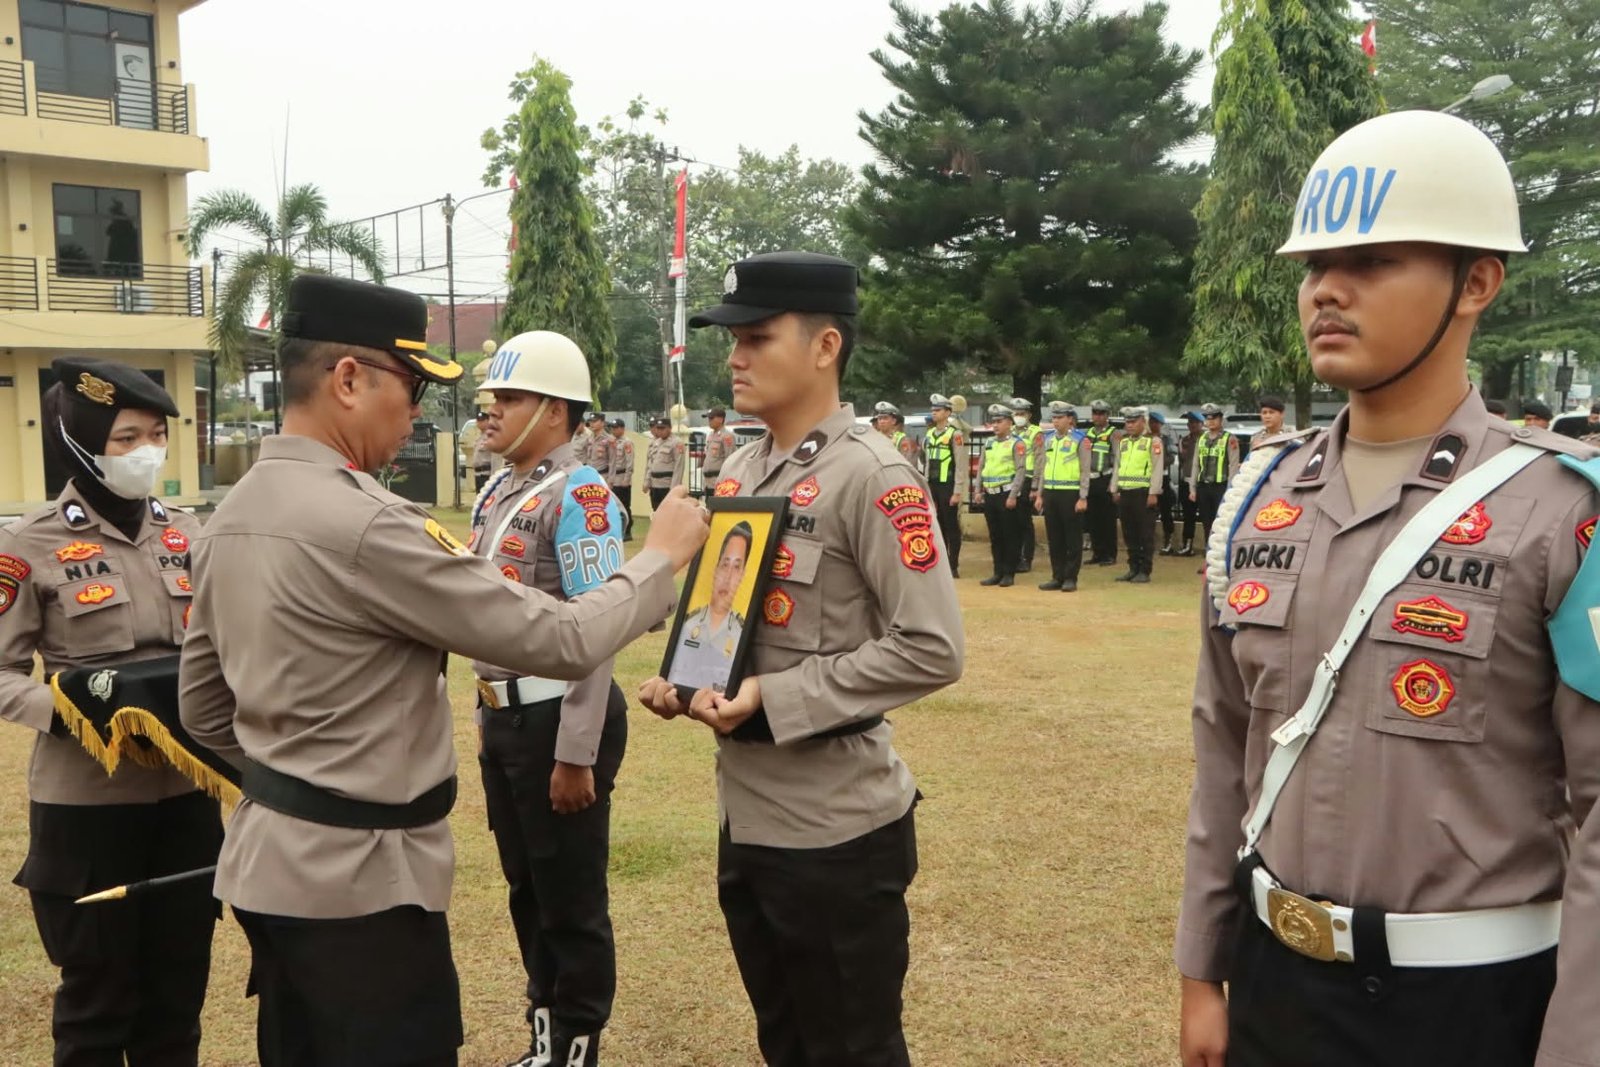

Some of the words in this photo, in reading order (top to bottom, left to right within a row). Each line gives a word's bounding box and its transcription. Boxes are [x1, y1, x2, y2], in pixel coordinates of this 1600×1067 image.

[487, 350, 521, 381] OV
[883, 488, 924, 506] POLRES
[511, 517, 536, 533] OLRI
[160, 556, 185, 569] PO
[1234, 543, 1296, 569] DICKI
[65, 561, 111, 580] NIA
[1416, 554, 1495, 588] OLRI
